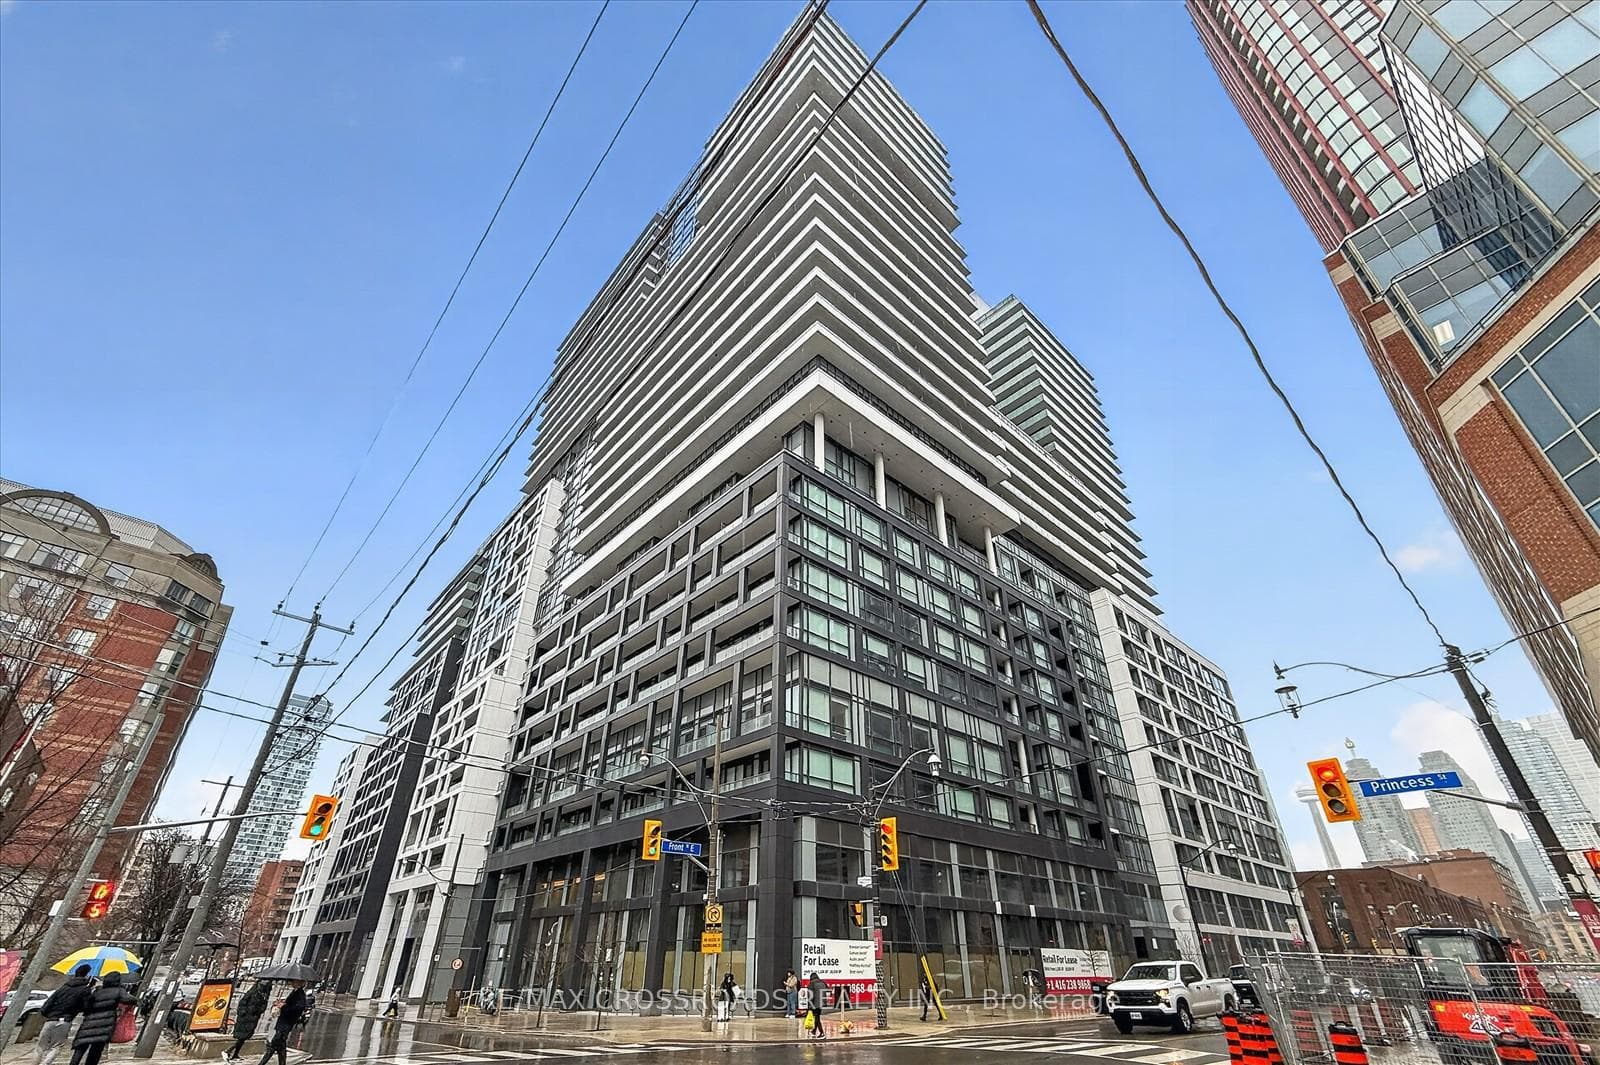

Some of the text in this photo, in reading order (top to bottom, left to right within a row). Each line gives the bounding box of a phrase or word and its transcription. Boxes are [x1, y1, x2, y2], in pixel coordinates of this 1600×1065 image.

[1370, 776, 1434, 793] Princess
[669, 842, 684, 852] Front
[803, 944, 826, 955] Retail
[803, 956, 840, 966] For Lease
